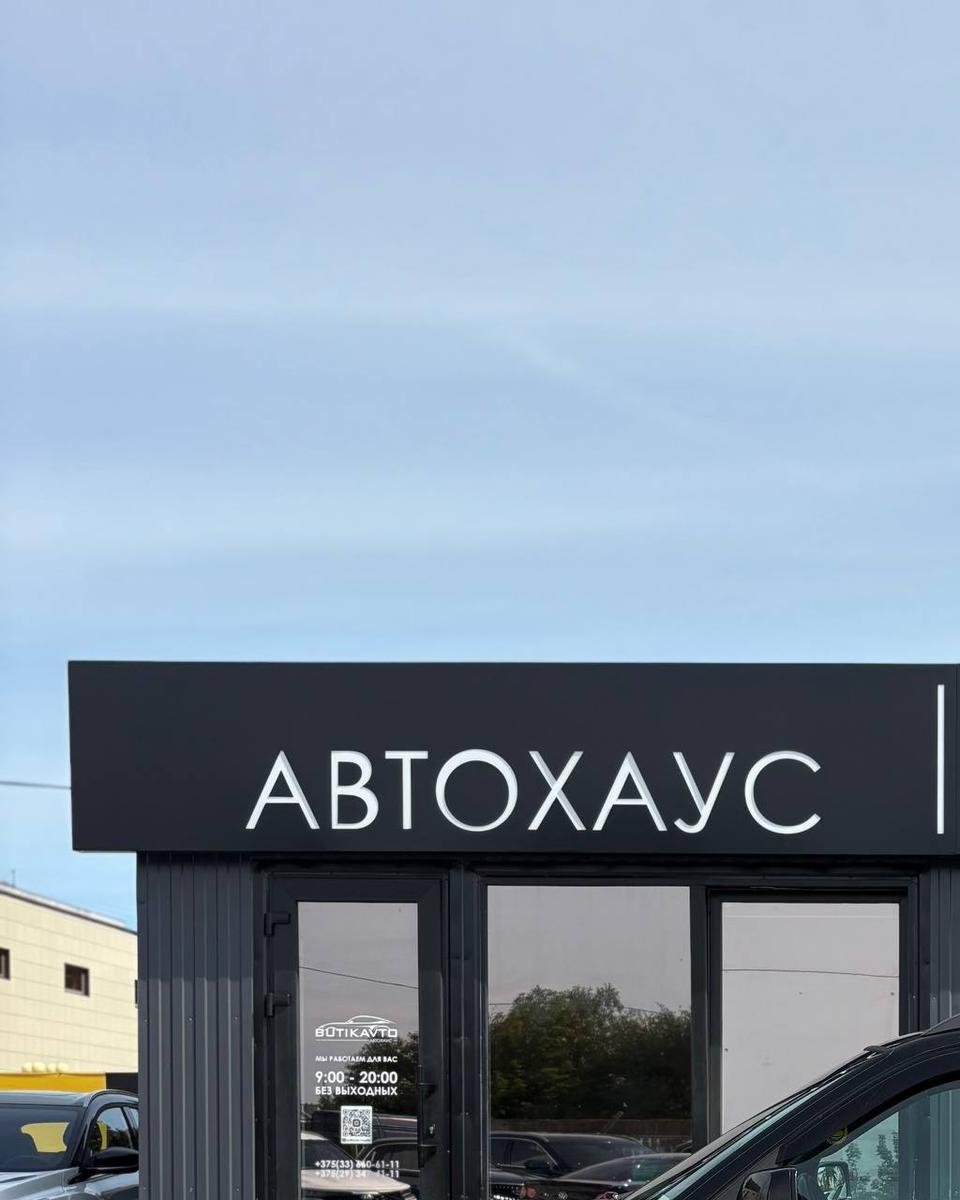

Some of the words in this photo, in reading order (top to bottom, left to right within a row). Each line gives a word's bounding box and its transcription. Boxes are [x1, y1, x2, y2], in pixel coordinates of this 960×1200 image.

[245, 748, 822, 835] АВТОХАУС
[315, 1028, 398, 1038] BUTIKAVTO
[315, 1055, 328, 1063] МЫ
[329, 1055, 366, 1063] РАБОТАЕМ
[367, 1055, 382, 1063] ДЛЯ
[383, 1055, 398, 1063] ВАС
[315, 1071, 345, 1084] 9:00
[359, 1071, 398, 1084] 20:00
[315, 1086, 332, 1096] БЕЗ
[335, 1086, 398, 1097] ВЫХОДНЫХ
[315, 1159, 353, 1169] +375(33)
